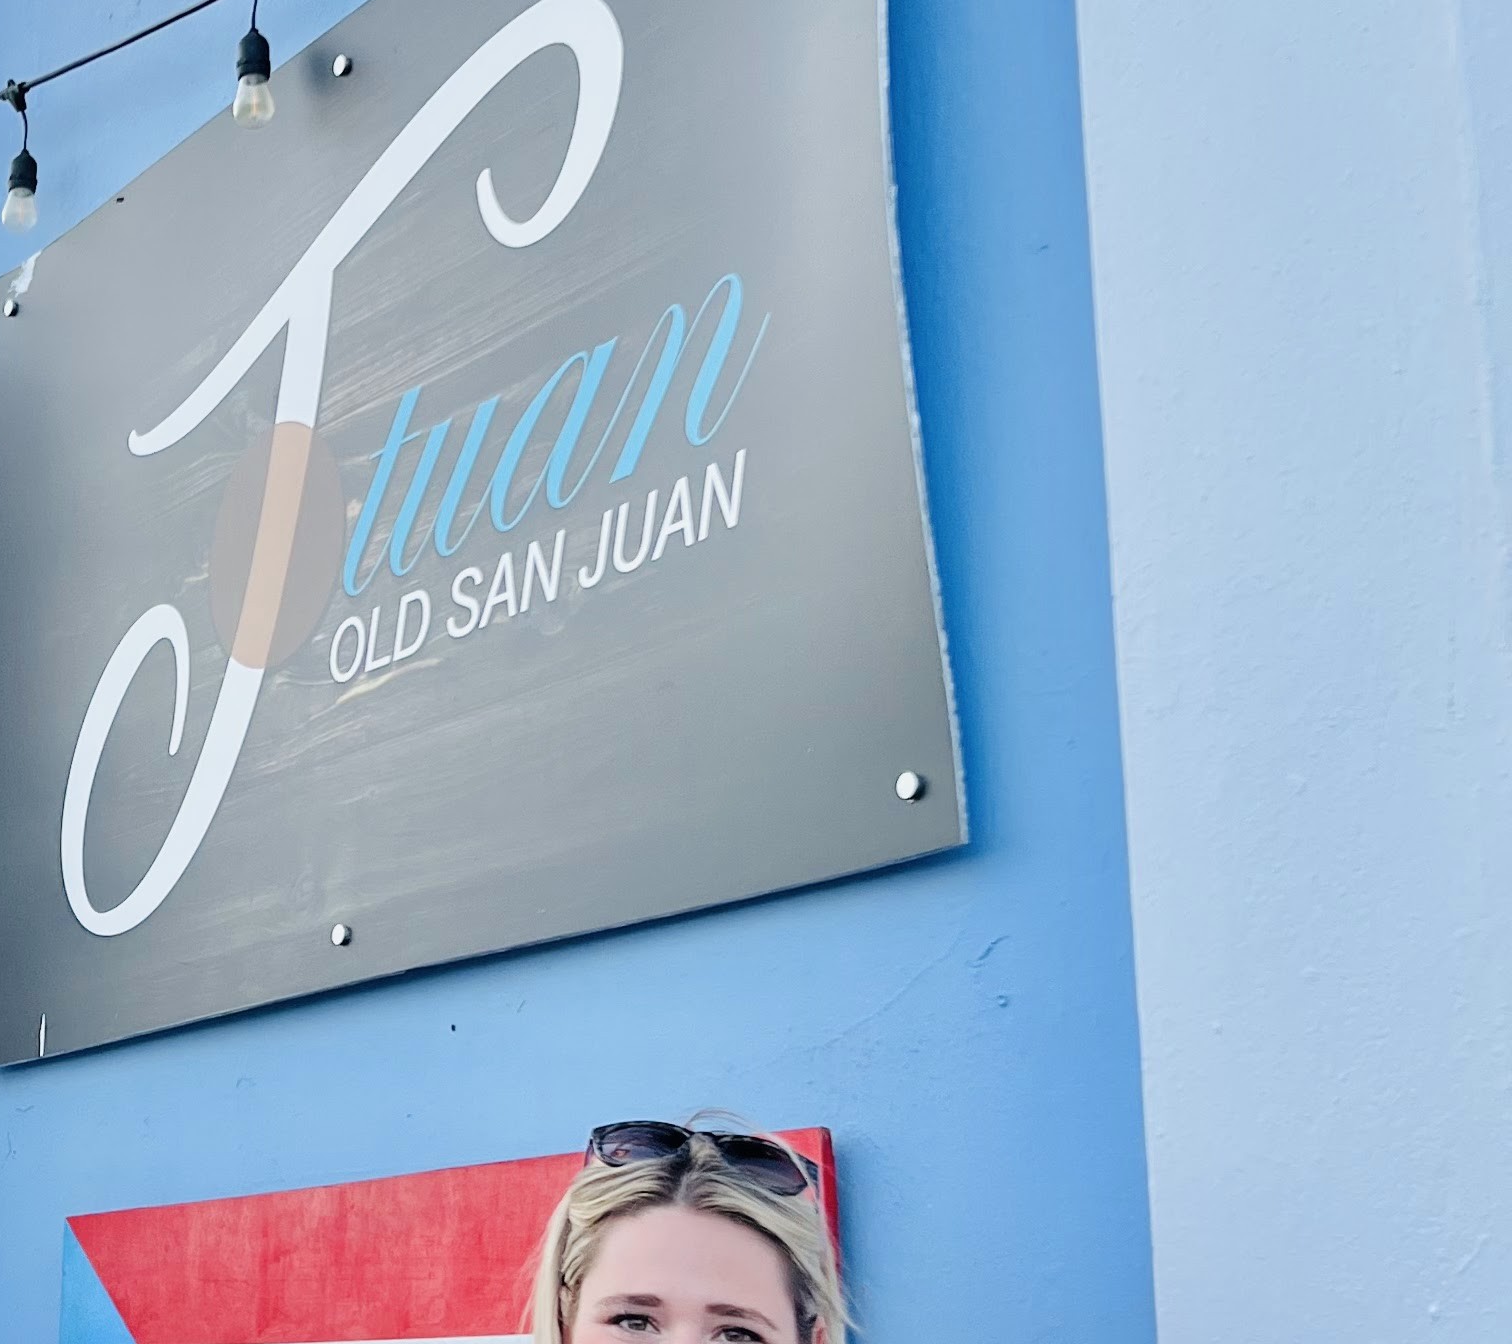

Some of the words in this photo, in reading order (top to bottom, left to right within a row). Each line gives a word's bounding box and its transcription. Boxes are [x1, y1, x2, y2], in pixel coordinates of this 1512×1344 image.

[329, 589, 431, 683] OLD
[446, 529, 566, 639] SAN
[578, 448, 747, 589] JUAN
